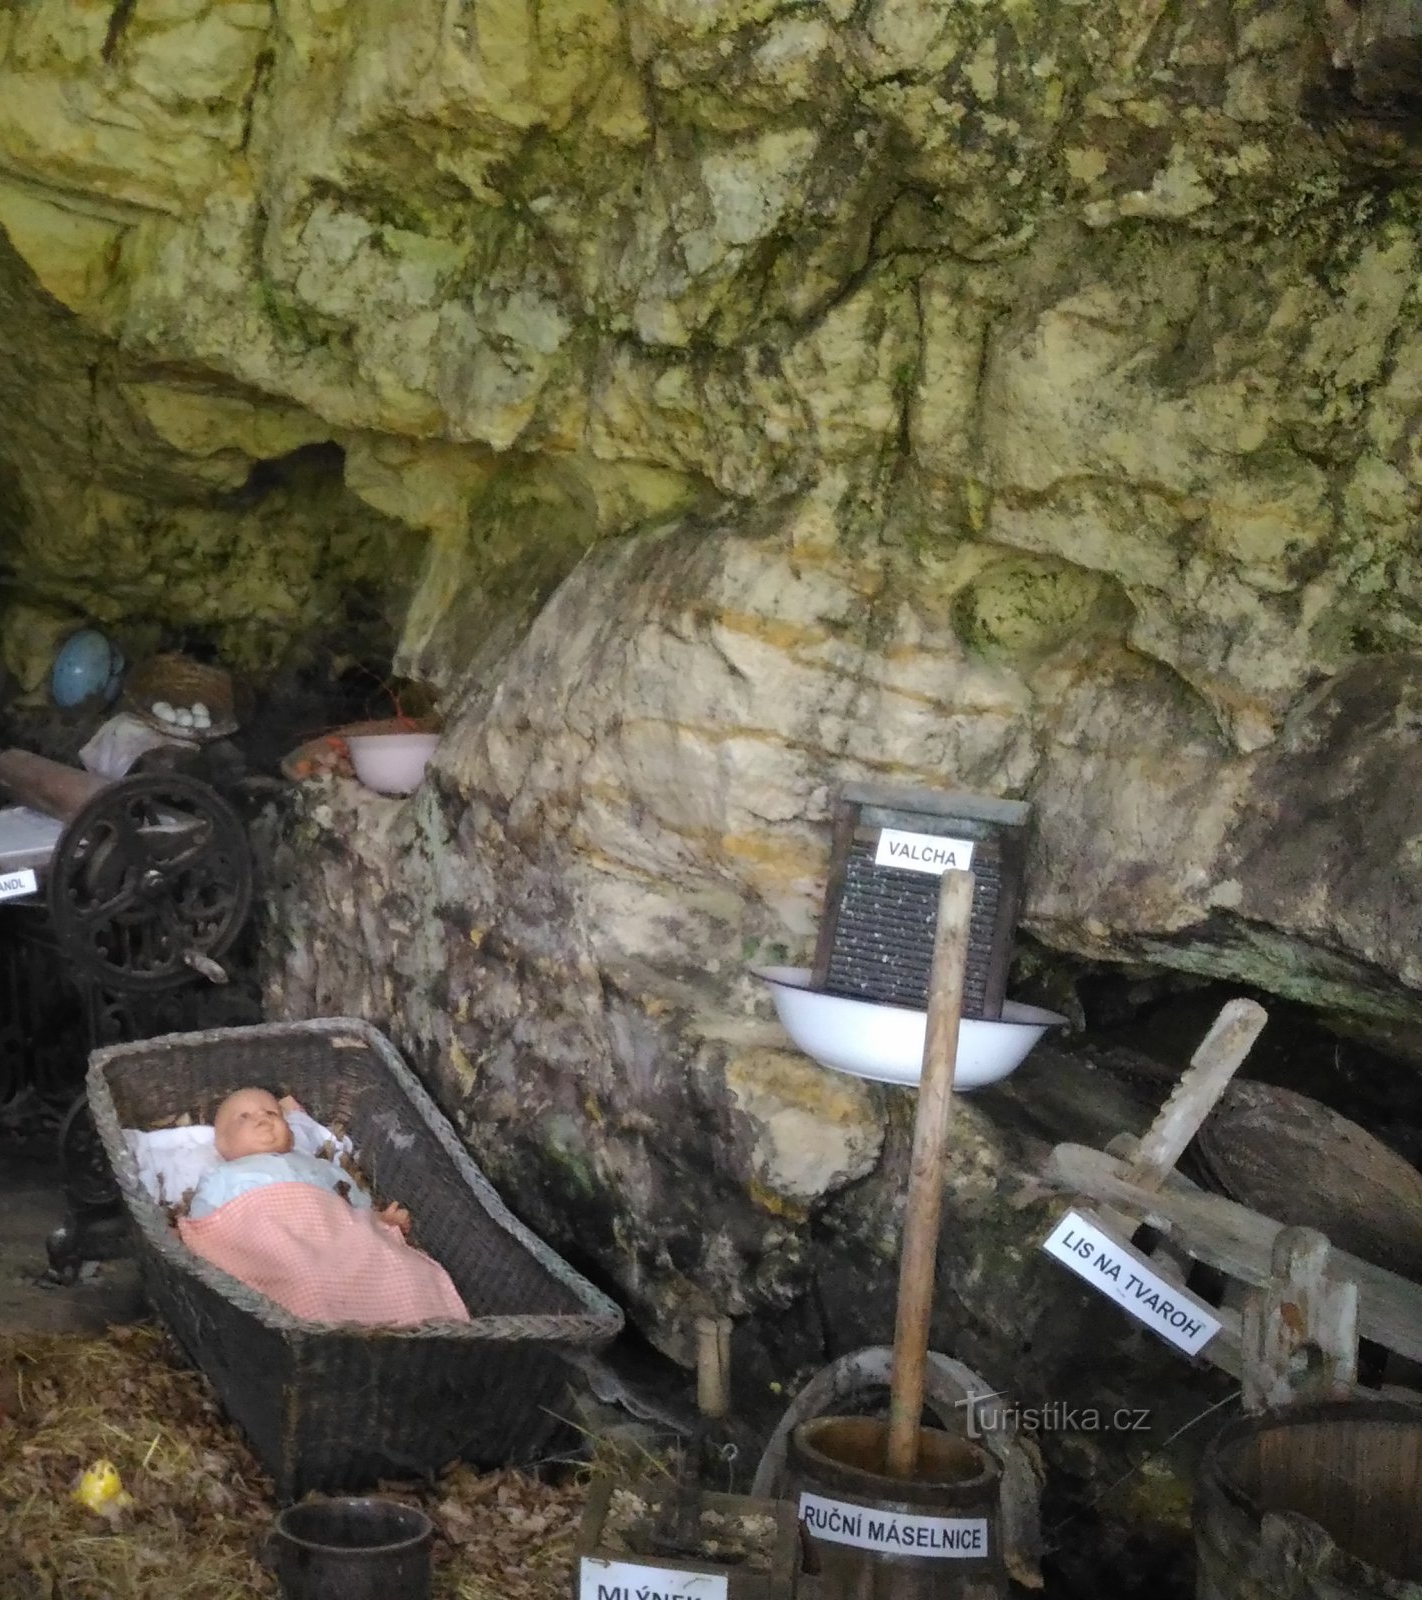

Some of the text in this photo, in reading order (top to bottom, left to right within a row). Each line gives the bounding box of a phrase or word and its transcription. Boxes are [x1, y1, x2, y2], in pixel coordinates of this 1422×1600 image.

[889, 840, 956, 867] VALCHA
[1062, 1230, 1203, 1338] LIS NA TVAROH
[804, 1505, 982, 1550] RUČNÍ MÁSELNICE
